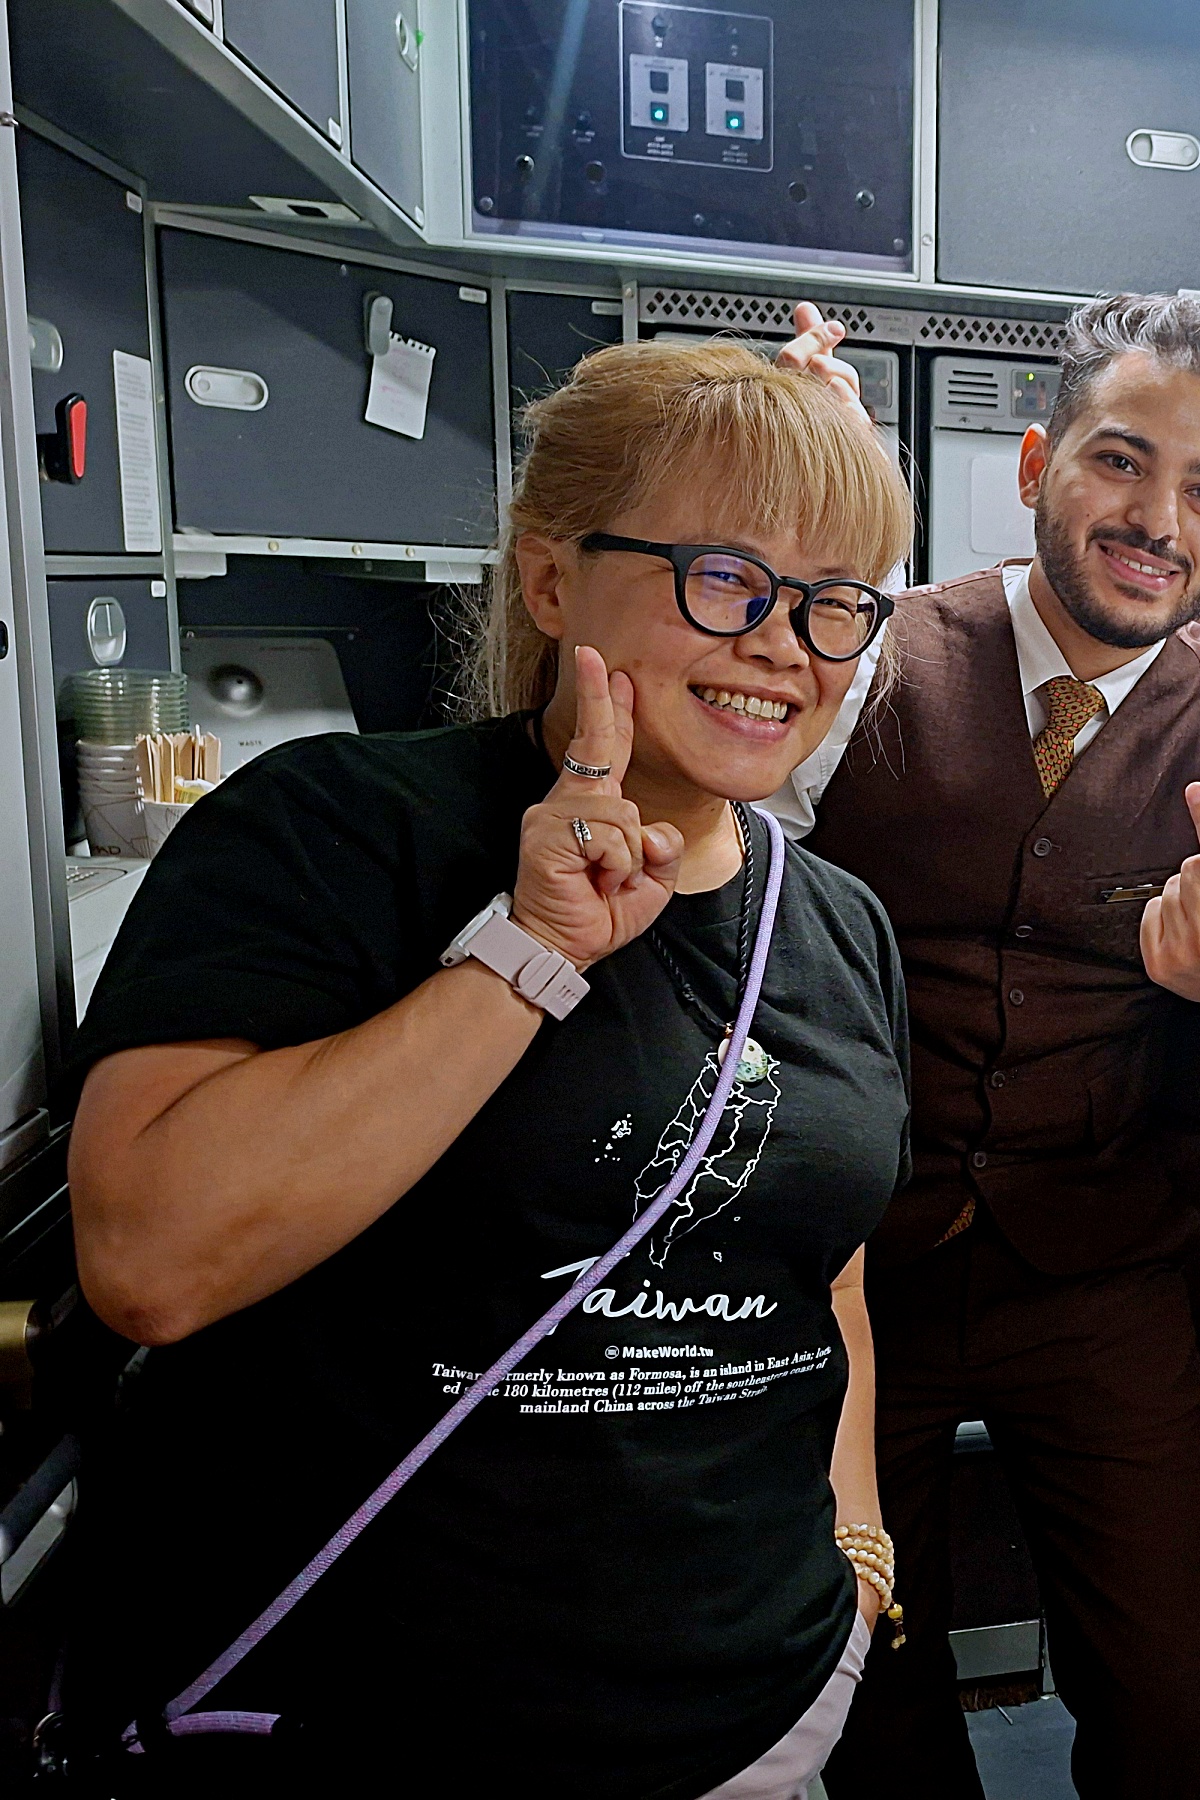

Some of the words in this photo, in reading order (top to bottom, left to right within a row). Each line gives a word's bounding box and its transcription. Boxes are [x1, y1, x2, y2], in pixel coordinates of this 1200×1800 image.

[622, 1345, 714, 1358] MakeWorld.tw
[442, 1382, 461, 1394] ed
[503, 1384, 528, 1397] 180
[531, 1384, 608, 1397] kilometres
[612, 1384, 641, 1399] (112
[643, 1381, 682, 1397] miles)
[684, 1381, 704, 1393] off
[706, 1379, 725, 1391] the
[726, 1371, 788, 1389] southeastern
[789, 1362, 815, 1375] coast
[815, 1357, 829, 1370] of
[557, 1369, 606, 1381] known
[609, 1372, 624, 1381] as
[628, 1368, 686, 1381] Formosa,
[689, 1366, 700, 1378] is
[703, 1367, 717, 1377] an
[719, 1361, 752, 1376] island
[754, 1360, 765, 1371] in
[767, 1356, 790, 1370] East
[790, 1350, 814, 1365] Asia;
[520, 1400, 591, 1413] mainland
[593, 1399, 633, 1413] China
[637, 1401, 675, 1411] across
[677, 1396, 696, 1408] the
[698, 1392, 737, 1405] Taiwan
